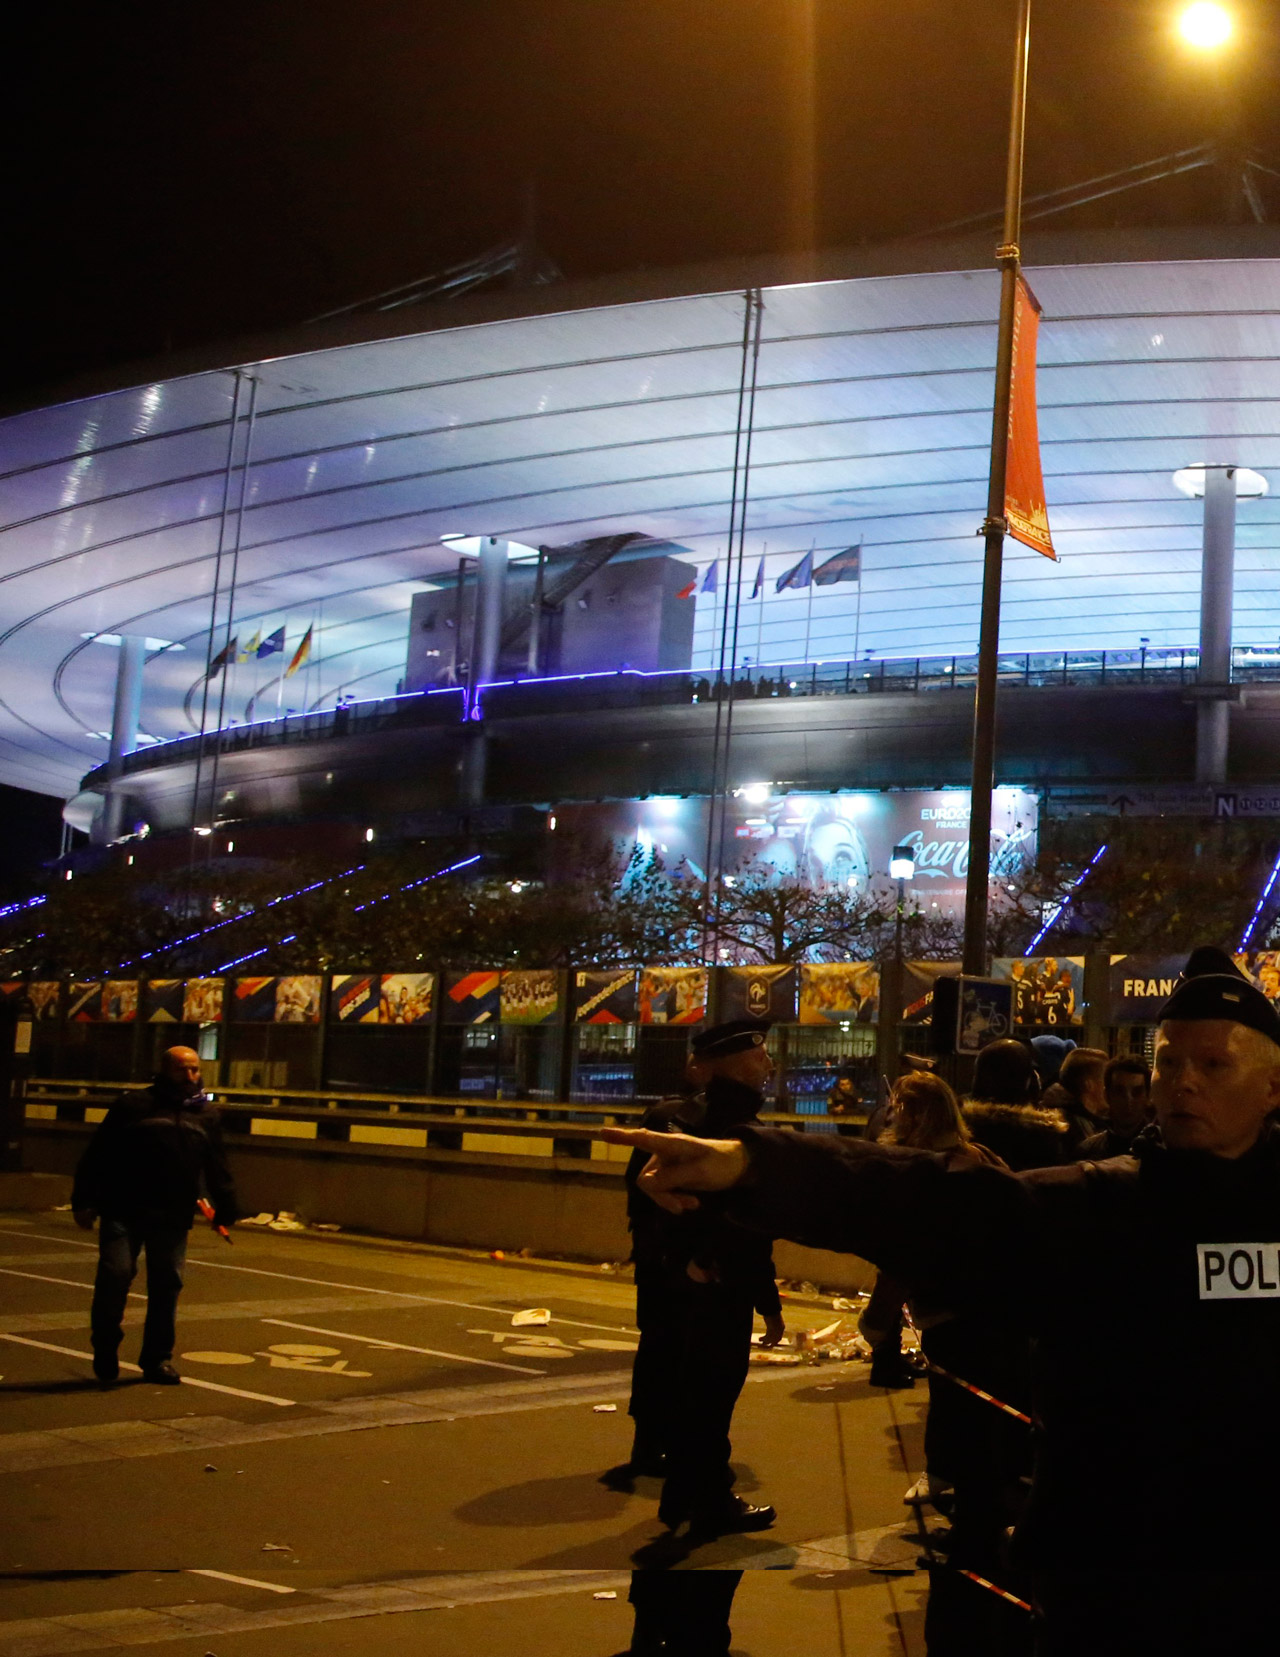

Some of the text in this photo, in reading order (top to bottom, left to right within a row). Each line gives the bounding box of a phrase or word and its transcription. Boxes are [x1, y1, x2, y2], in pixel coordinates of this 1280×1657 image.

[1217, 797, 1235, 816] N
[935, 820, 968, 829] FRANCE
[889, 830, 1033, 877] Coca-Cla
[1123, 979, 1179, 998] FRAN
[1048, 1006, 1058, 1025] 6
